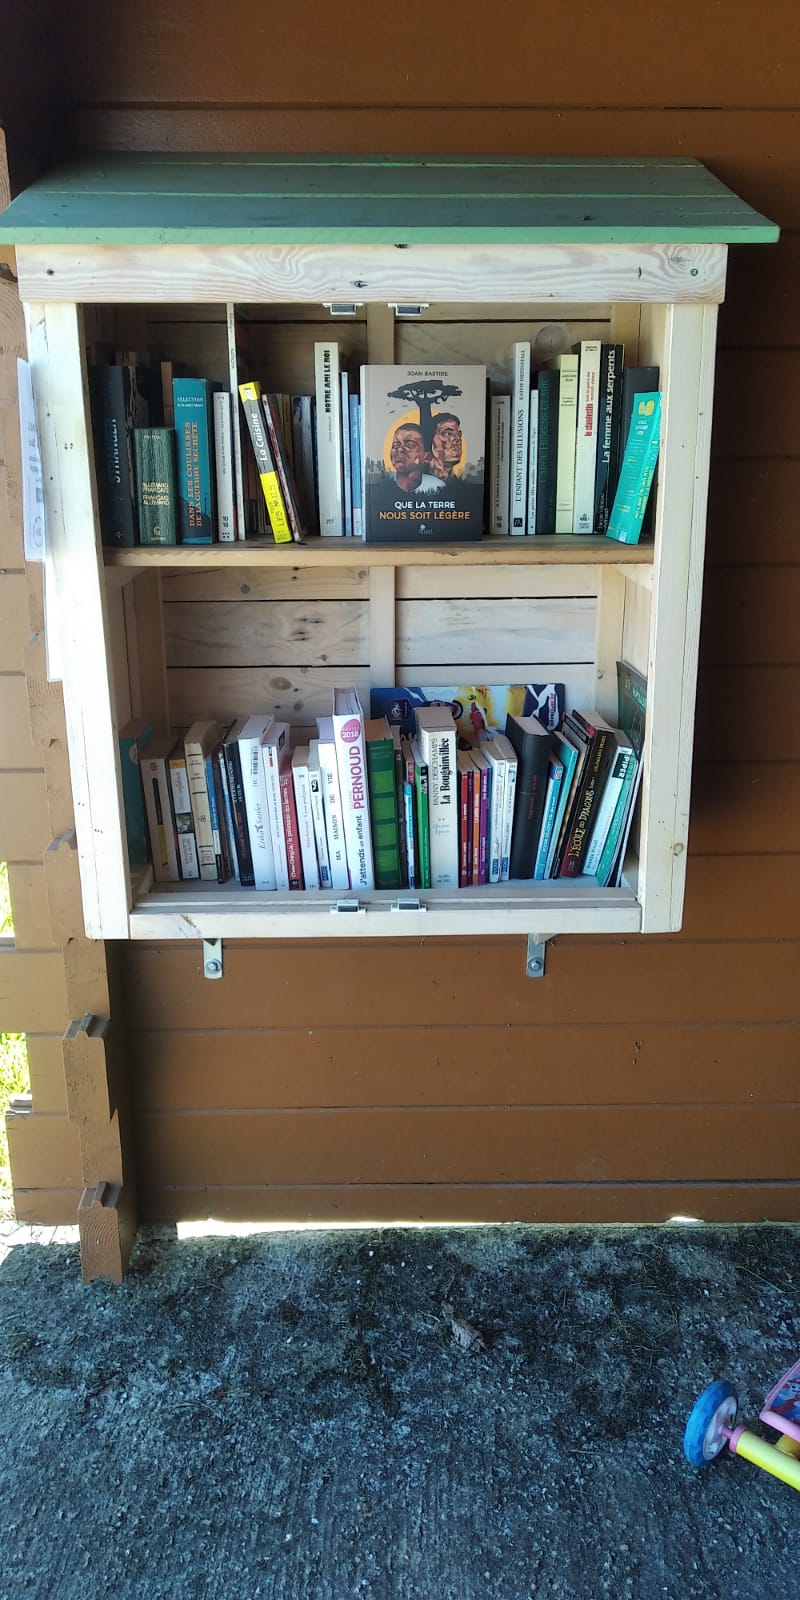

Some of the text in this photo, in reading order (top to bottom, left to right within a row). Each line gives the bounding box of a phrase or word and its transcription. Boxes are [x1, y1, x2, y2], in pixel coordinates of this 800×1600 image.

[324, 363, 330, 373] LE
[606, 349, 615, 394] serpents
[251, 412, 268, 462] La Cuisine
[603, 414, 612, 448] femme
[184, 422, 193, 478] COULISSES
[602, 449, 610, 463] La
[193, 465, 201, 501] GUERRE
[515, 465, 523, 502] L'ENFANT
[195, 502, 201, 513] LA
[379, 509, 471, 520] NOUS SOIT LÉGÈRE
[394, 501, 455, 510] QUE LA TERRE
[195, 515, 202, 526] DE
[349, 745, 365, 810] PERNOUD
[440, 737, 453, 805] La Bougainvillée
[618, 755, 629, 778] PIPER
[329, 793, 336, 804] DE
[432, 780, 440, 806] FANNY
[579, 790, 595, 822] DRAGONS
[355, 815, 363, 841] enfant
[336, 850, 342, 861] MA
[358, 848, 368, 886] J'attends
